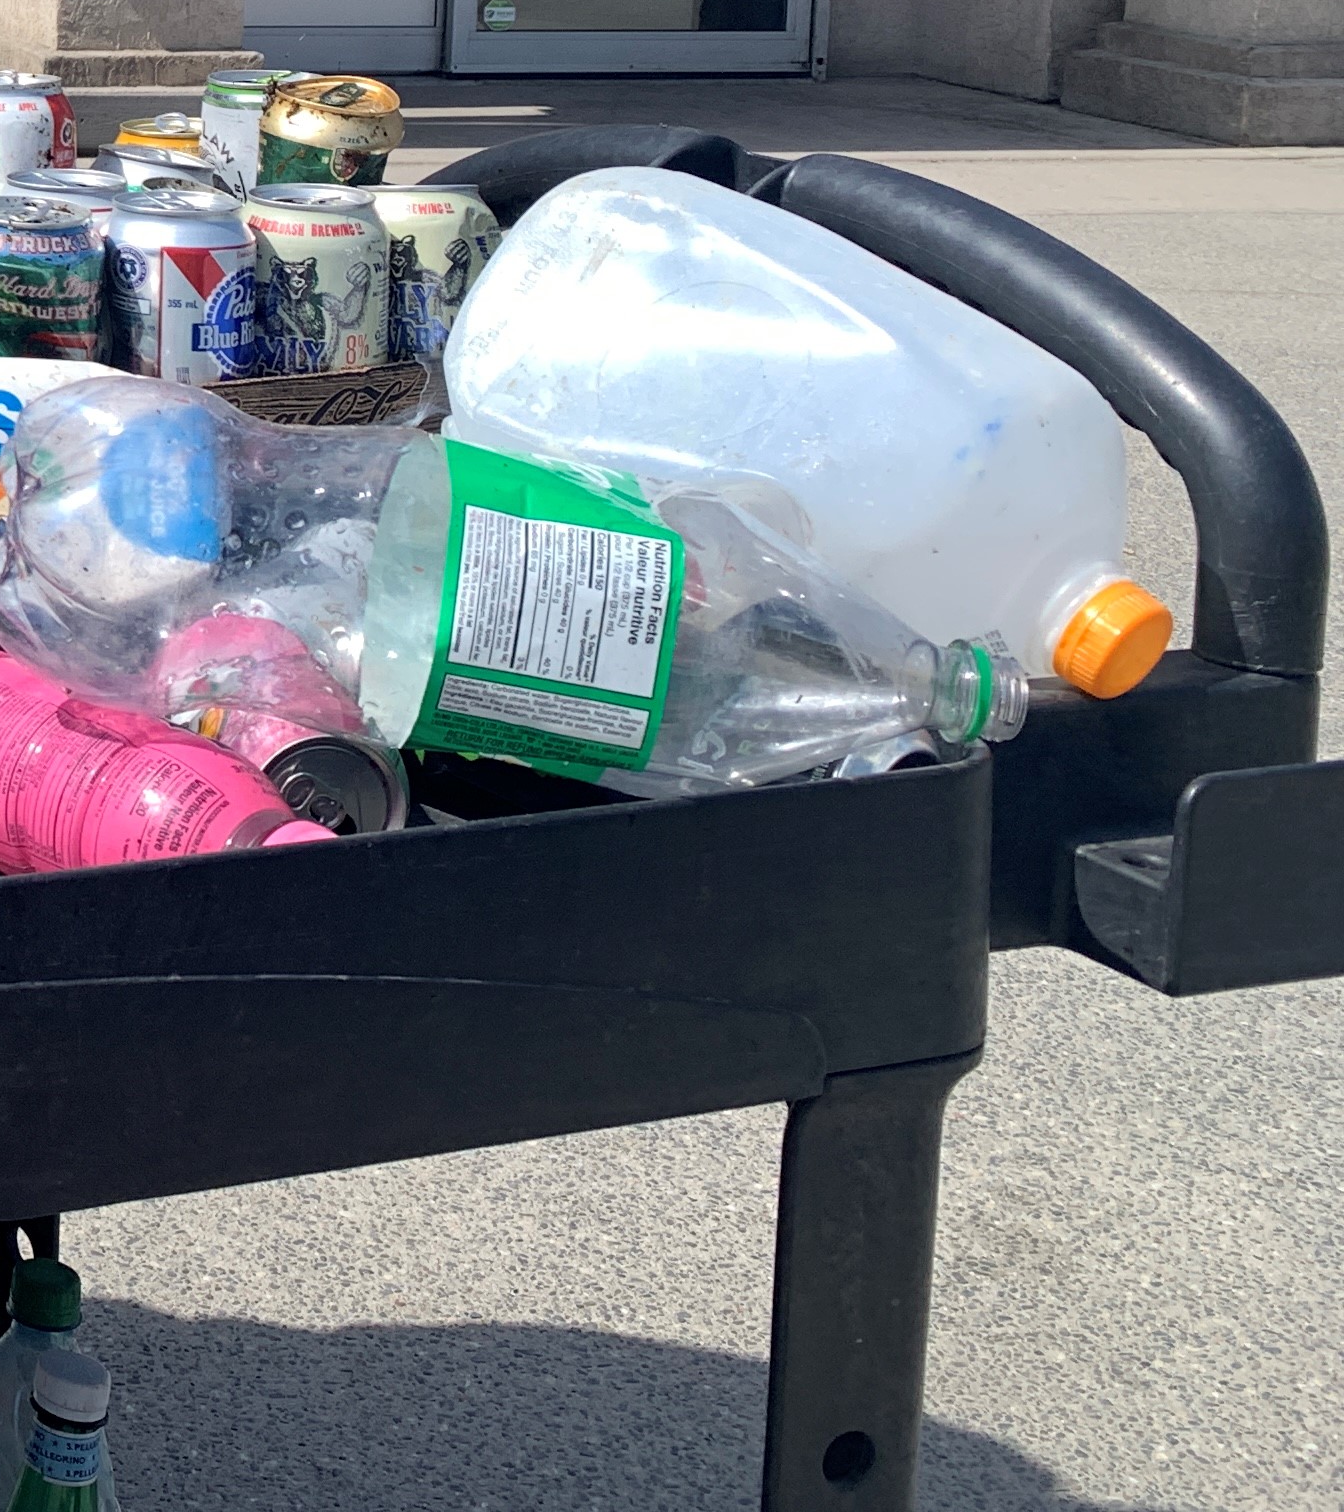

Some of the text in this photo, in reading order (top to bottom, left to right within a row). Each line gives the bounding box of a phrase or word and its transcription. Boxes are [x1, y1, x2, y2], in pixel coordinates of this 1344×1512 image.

[9, 235, 77, 255] TRUCK
[198, 326, 239, 349] Blue
[592, 532, 609, 591] Calories 150
[628, 540, 650, 646] Valeur nutritive
[645, 543, 668, 645] Nutrition Facts
[168, 786, 216, 854] Nutrition Facts
[178, 779, 200, 809] Valeur
